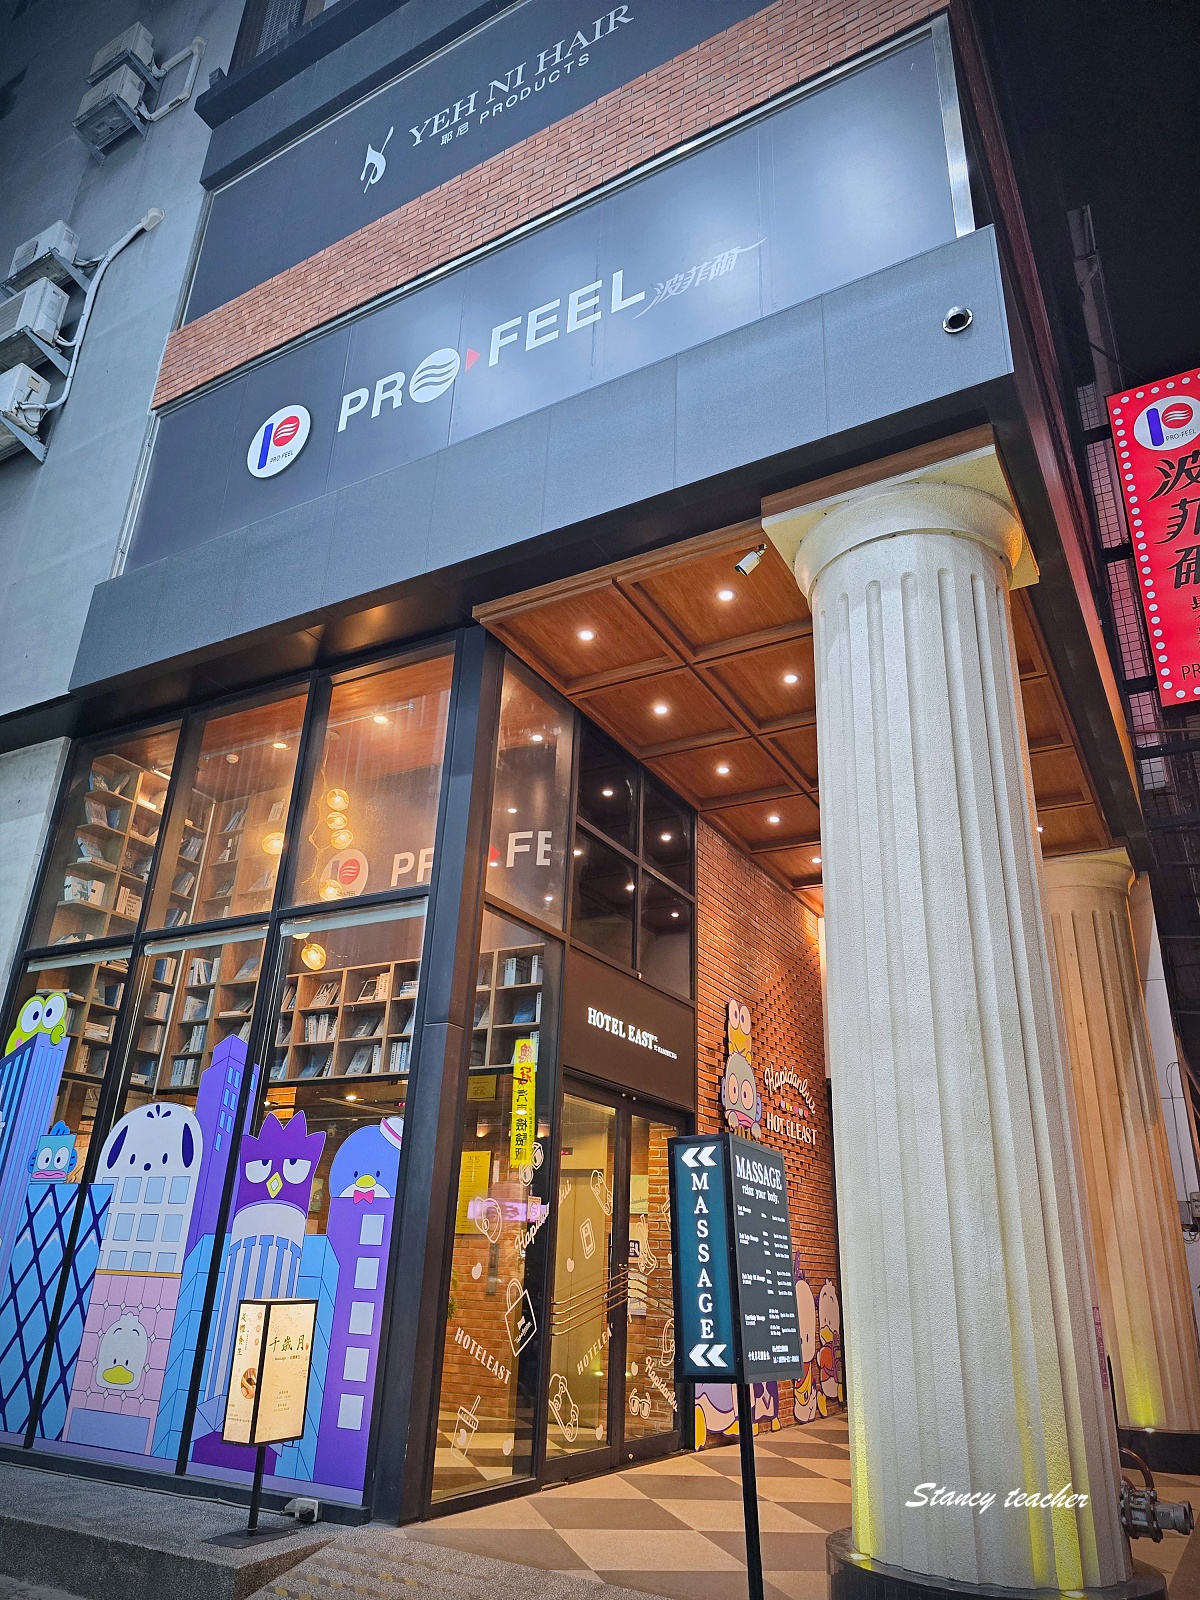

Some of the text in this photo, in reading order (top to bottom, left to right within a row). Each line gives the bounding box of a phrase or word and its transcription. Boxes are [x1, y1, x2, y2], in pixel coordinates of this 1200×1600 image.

[408, 4, 634, 147] YEH NI HAIR
[479, 53, 590, 124] PRODUCTS
[440, 121, 469, 145] 耶尼
[488, 268, 646, 368] FEEL
[1165, 428, 1197, 441] PRO-FEEL
[587, 1006, 657, 1051] HOTEL EAST
[766, 1111, 817, 1145] HOTELEAST
[735, 1154, 783, 1190] MASSAGE
[691, 1172, 714, 1339] MASSAGE
[455, 1326, 512, 1385] HOTELEAST
